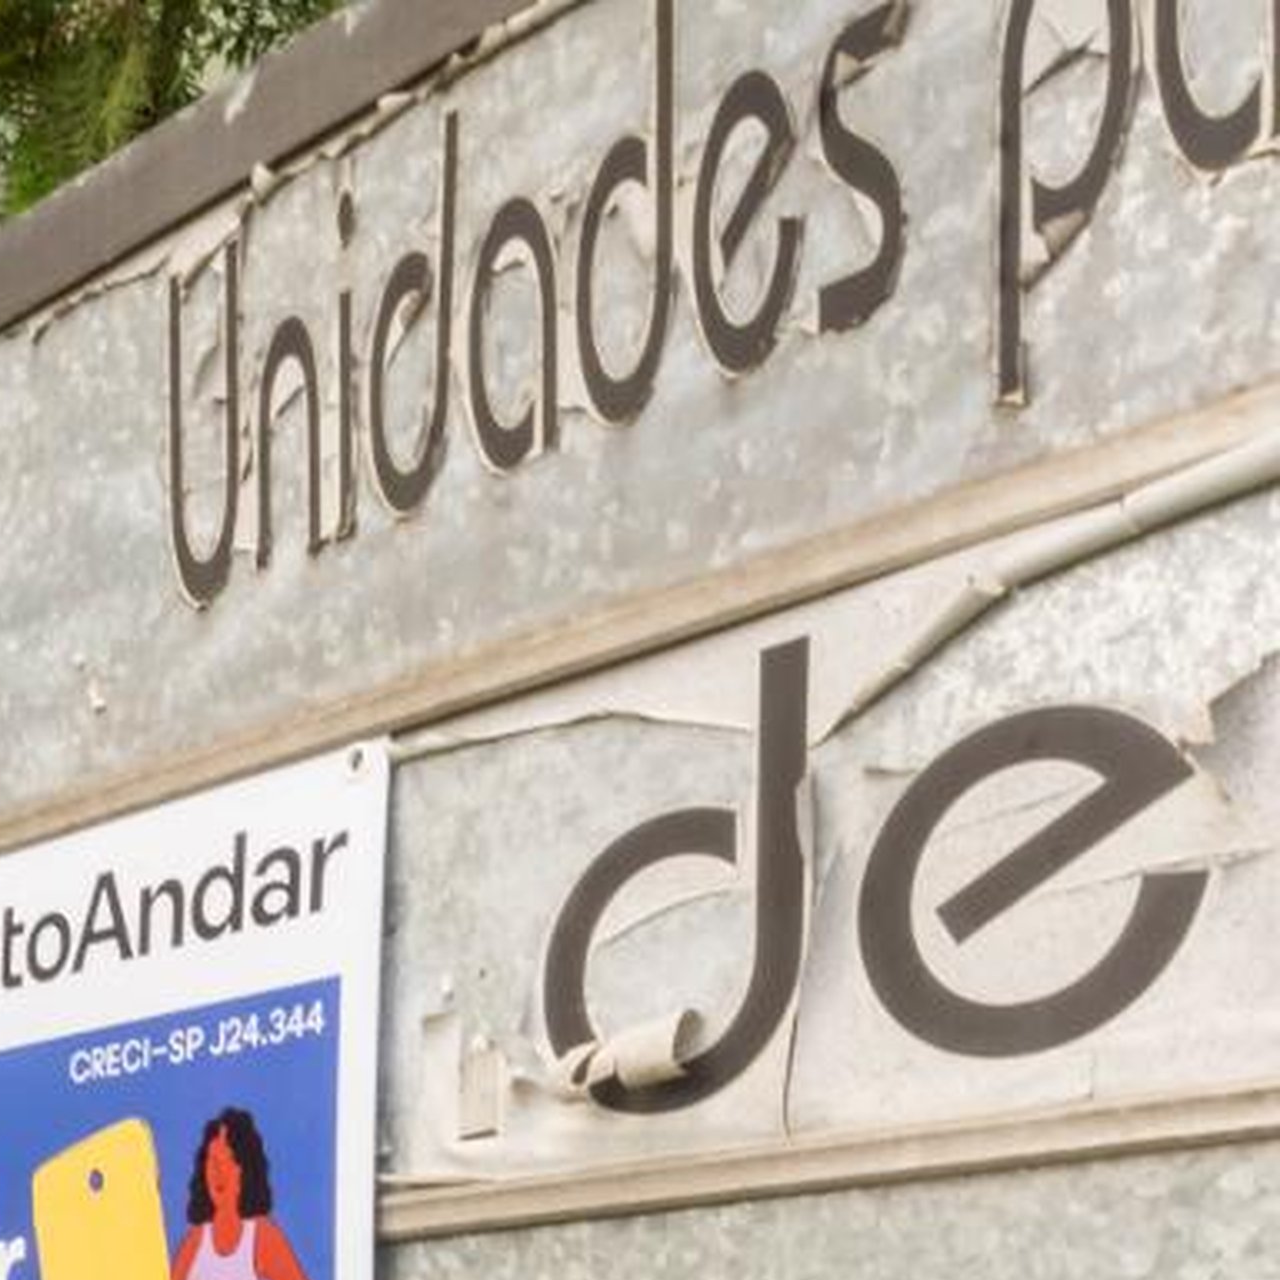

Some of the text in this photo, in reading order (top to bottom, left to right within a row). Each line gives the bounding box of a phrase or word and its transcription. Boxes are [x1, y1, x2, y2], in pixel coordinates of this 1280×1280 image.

[168, 0, 908, 607] Unidades
[68, 1000, 325, 1084] CRECI-SP J24.344
[543, 635, 1208, 1114] de
